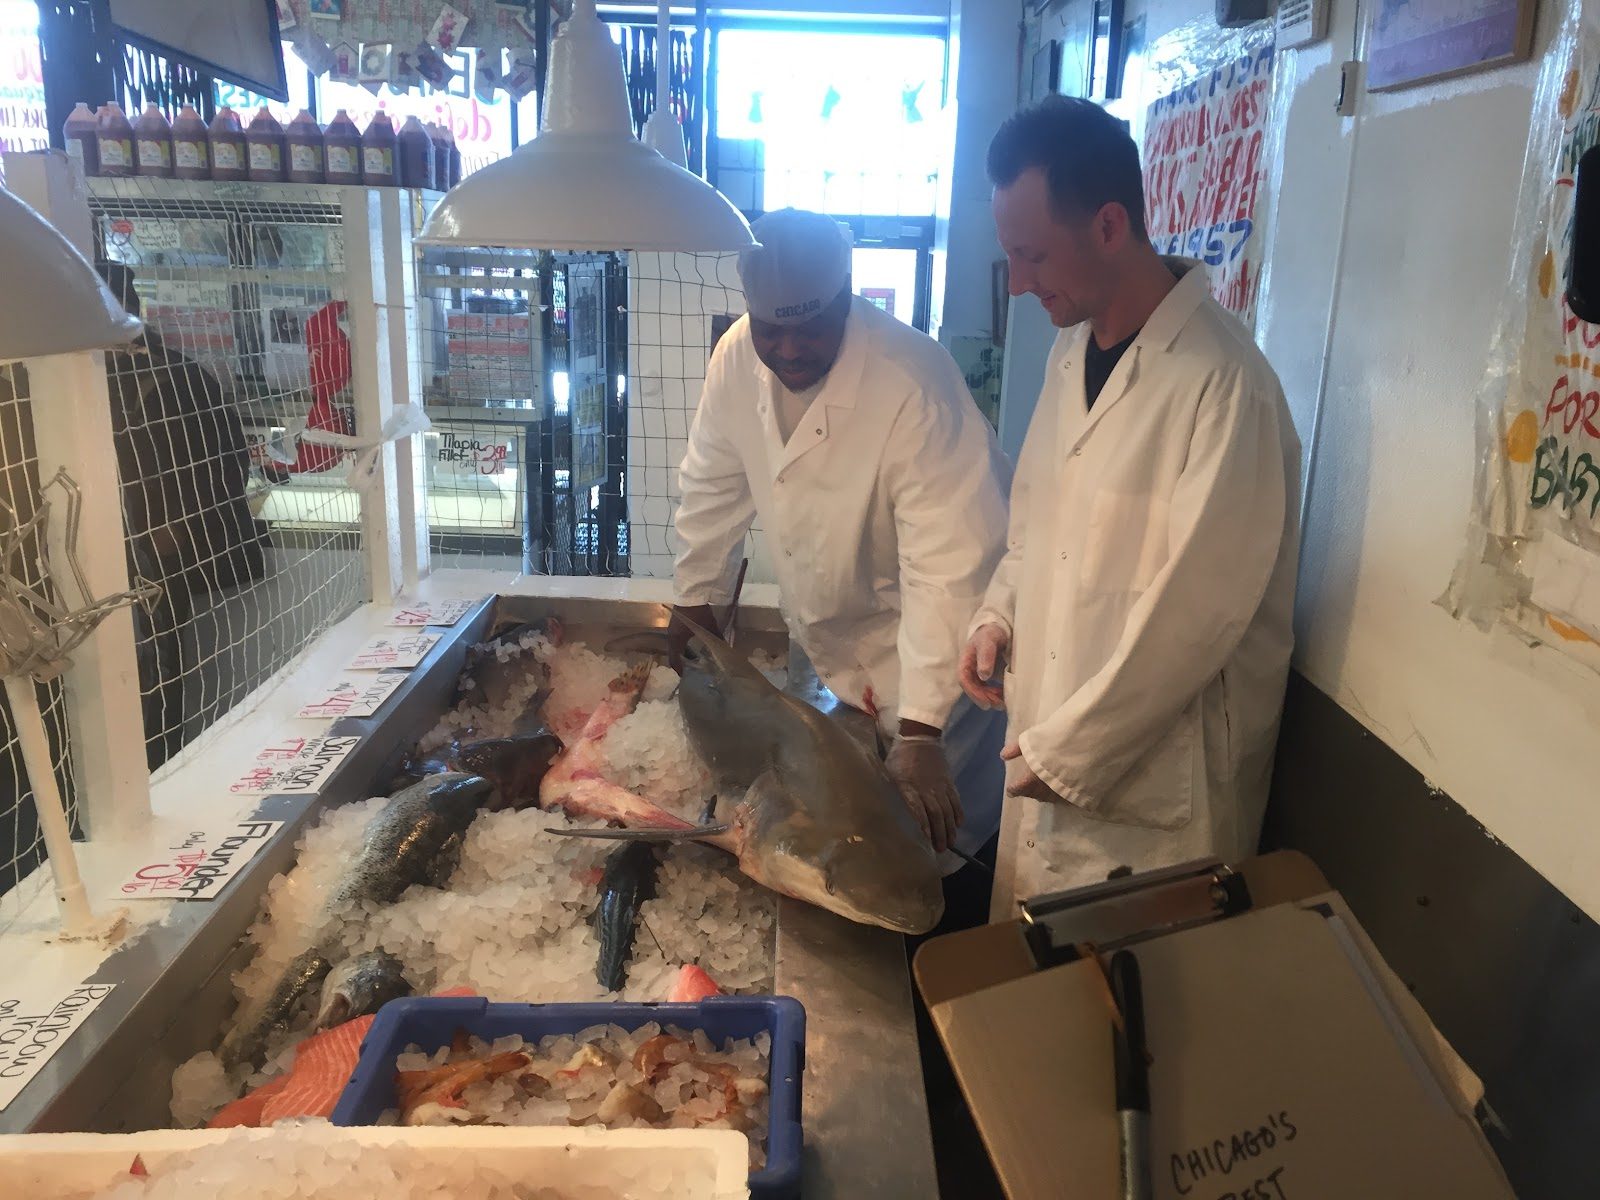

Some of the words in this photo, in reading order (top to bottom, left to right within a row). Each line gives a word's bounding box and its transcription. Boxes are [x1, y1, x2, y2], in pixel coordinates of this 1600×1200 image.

[775, 298, 820, 317] CHICAGO
[283, 737, 358, 790] Salmon
[179, 822, 273, 898] Flounder
[0, 985, 111, 1078] Rainbow
[1170, 1110, 1297, 1195] CHICAGO'S
